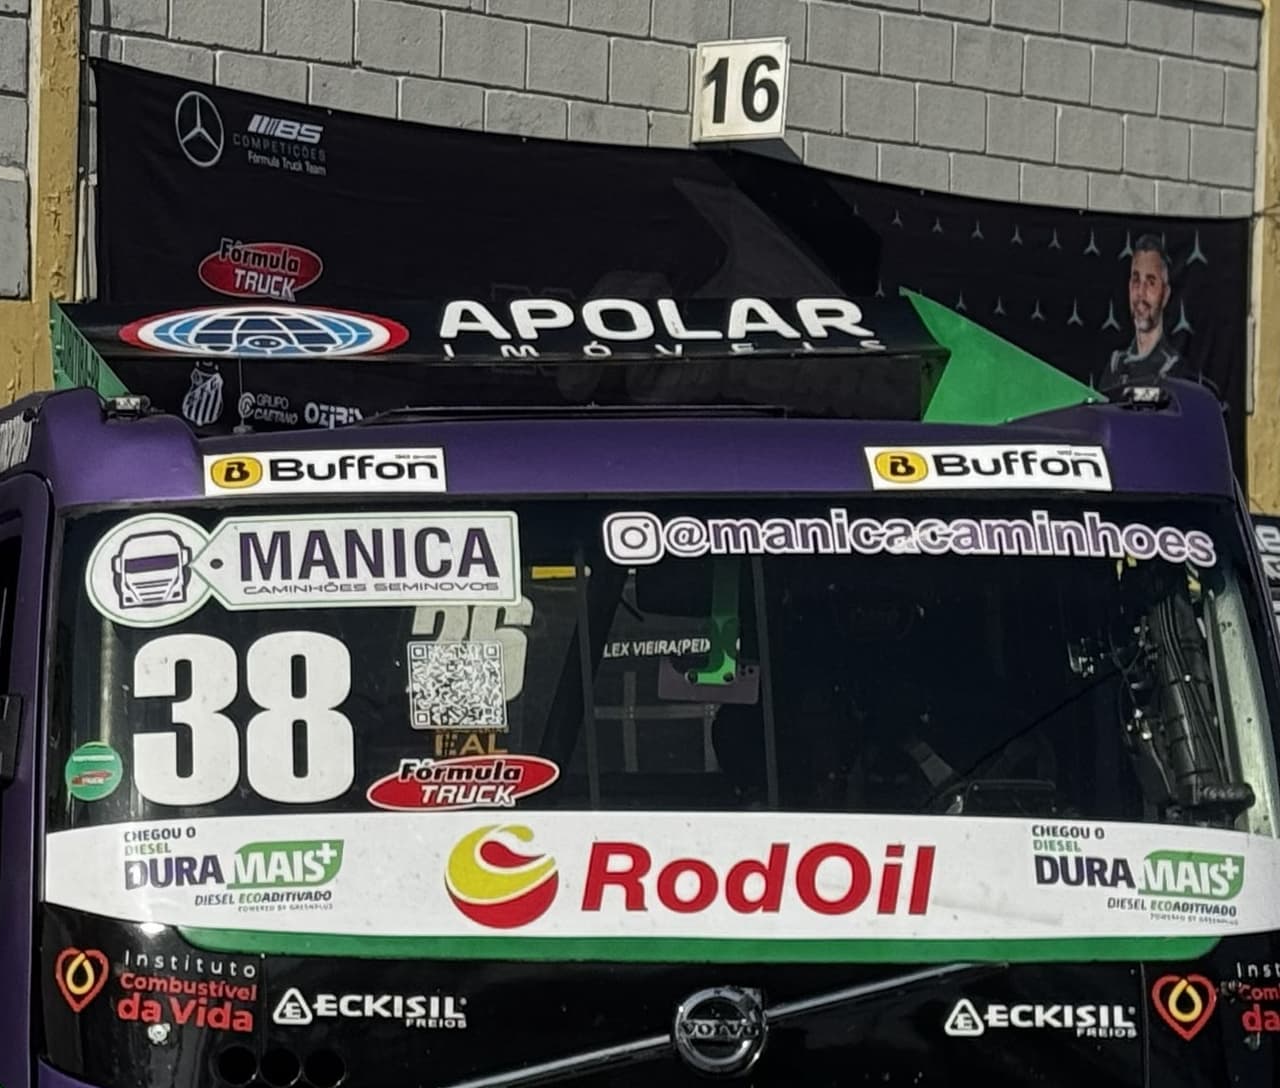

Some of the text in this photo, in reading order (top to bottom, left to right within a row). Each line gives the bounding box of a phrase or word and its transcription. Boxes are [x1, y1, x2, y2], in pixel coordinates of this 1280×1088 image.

[701, 54, 781, 125] 16
[233, 267, 297, 301] TRUCK
[438, 297, 877, 341] APOLAR
[268, 455, 439, 482] Buffon
[930, 450, 1103, 478] Buffon
[663, 509, 1217, 567] @manicacaminhoes
[240, 527, 500, 583] MANICA
[242, 582, 500, 596] CAMINHÕES SEMINOVOS
[133, 631, 354, 806] 38
[398, 755, 523, 784] Fórmula
[420, 782, 518, 808] TRUCK
[186, 826, 197, 839] O
[1031, 824, 1105, 840] CHEGOU O
[1032, 839, 1082, 853] DIESEL
[124, 854, 226, 891] DURA
[580, 841, 938, 916] RodOil
[1034, 854, 1137, 890] DURA
[194, 890, 333, 907] DIESEL ECOADITIVADO
[1107, 897, 1238, 918] DIESEL ECOADITIVADO
[123, 948, 257, 979] Instituto
[119, 970, 258, 1002] Combustível
[117, 995, 255, 1033] da Vida
[312, 994, 465, 1020] ECKISIL
[983, 1005, 1137, 1031] ECKISIL
[404, 1017, 468, 1030] FREIOS
[680, 1020, 762, 1040] VOLVO
[1076, 1027, 1138, 1039] FREIOS
